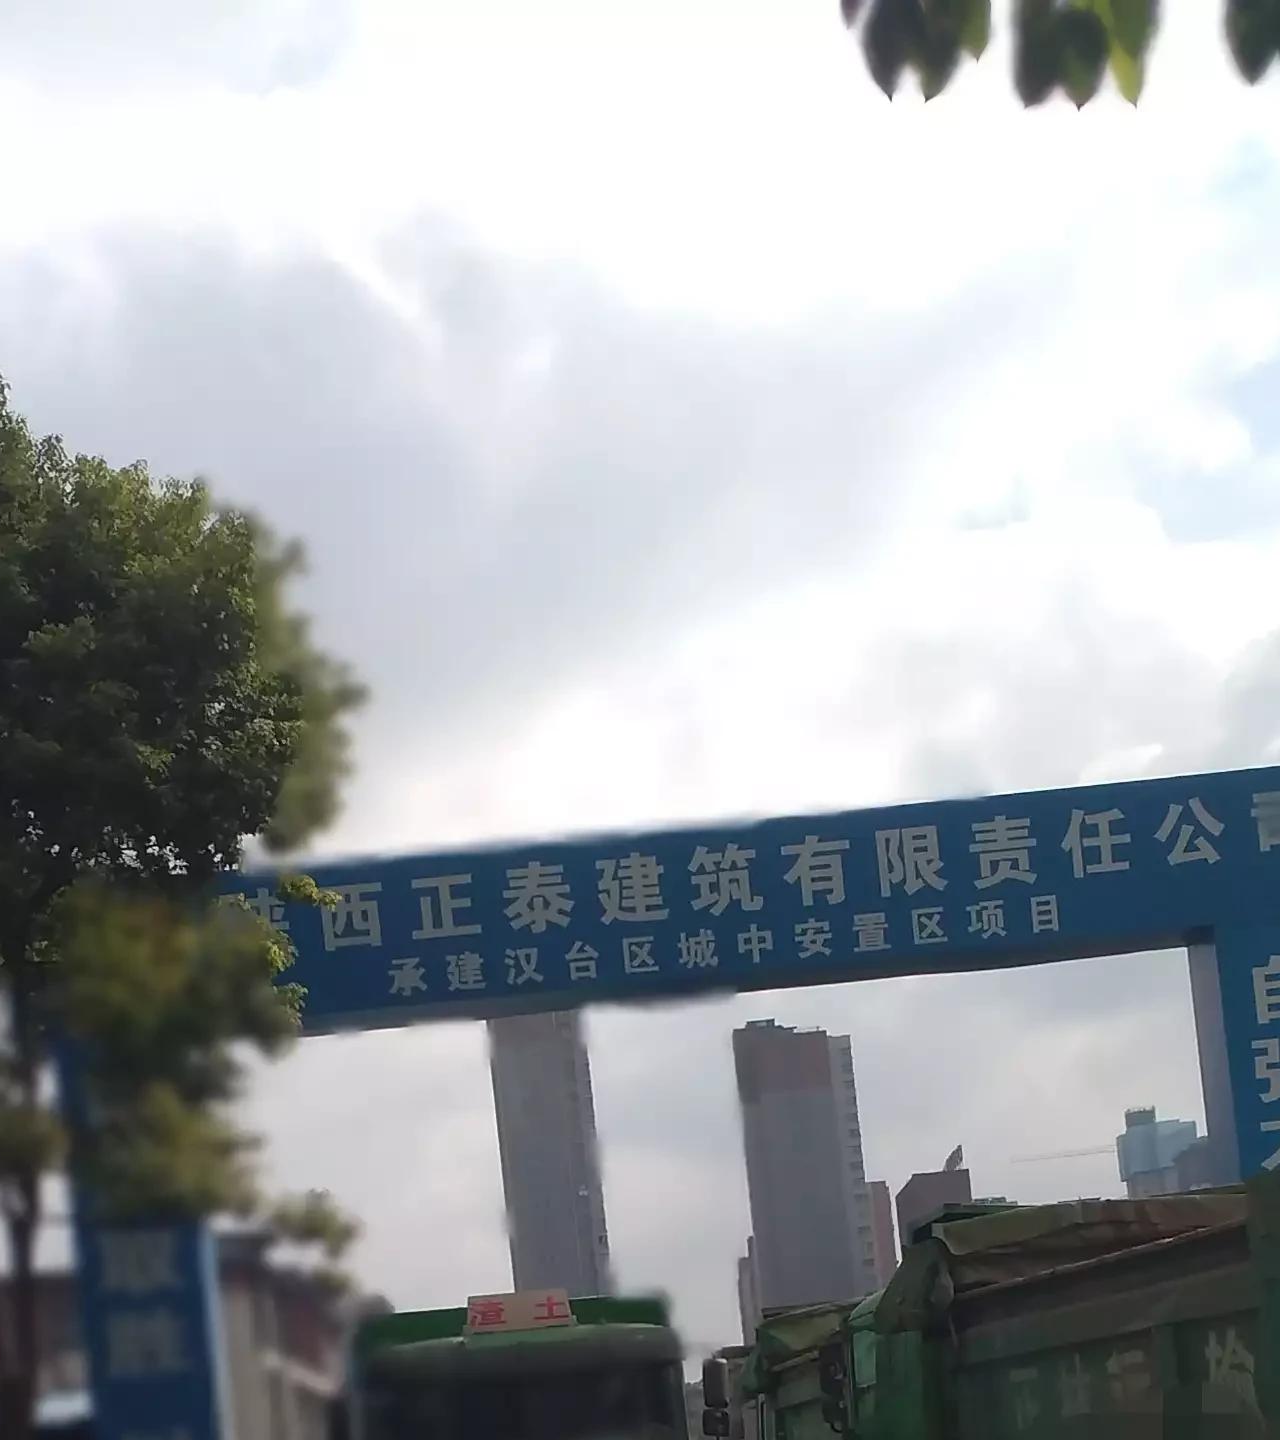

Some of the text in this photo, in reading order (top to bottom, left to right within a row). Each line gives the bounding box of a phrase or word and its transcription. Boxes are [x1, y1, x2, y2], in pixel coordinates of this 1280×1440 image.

[388, 895, 1060, 997] 承建汉台区城中安置区项目
